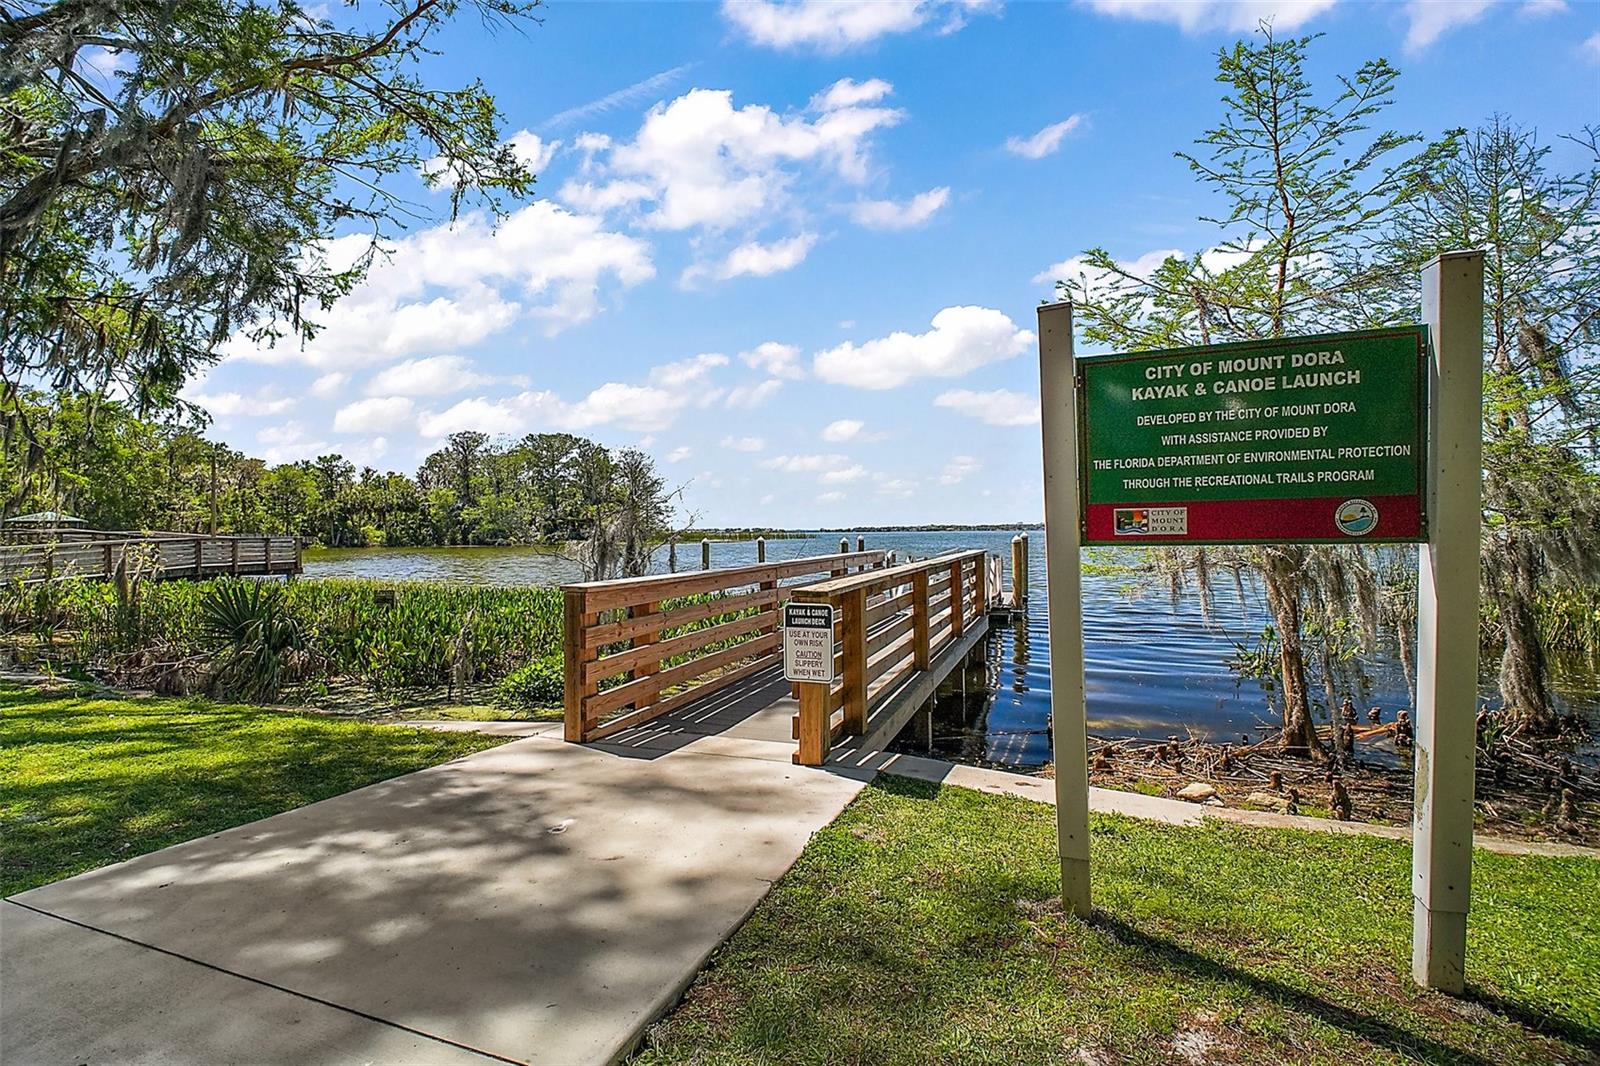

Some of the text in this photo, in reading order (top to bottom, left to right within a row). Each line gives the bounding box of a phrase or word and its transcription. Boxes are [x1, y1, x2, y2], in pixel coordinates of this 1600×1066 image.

[1145, 350, 1345, 380] CITY OF MOUNT DORA
[1132, 370, 1360, 401] KAYAK & CANOE LAUNCH
[1136, 402, 1357, 426] DEVELOPED BY THE CITY OF MOUNT DORA
[1161, 426, 1328, 446] WITH ASSISTANCE PROVIDED BY
[1093, 445, 1411, 470] THE FLORIDA DEPARTMENT OF ENVIRONMENTAL PROTECTION
[1123, 469, 1375, 489] THROUGH THE RECREATIONAL TRAILS PROGRAM
[788, 608, 829, 617] KAYAK & CANOE
[791, 617, 826, 626] LAUNCH DECK
[789, 630, 801, 638] USE
[811, 631, 829, 639] YOUR
[793, 639, 824, 647] OWN RISK
[795, 650, 823, 659] CAUTION
[795, 659, 823, 668] SLIPPERY
[793, 668, 825, 677] WHEN WET
